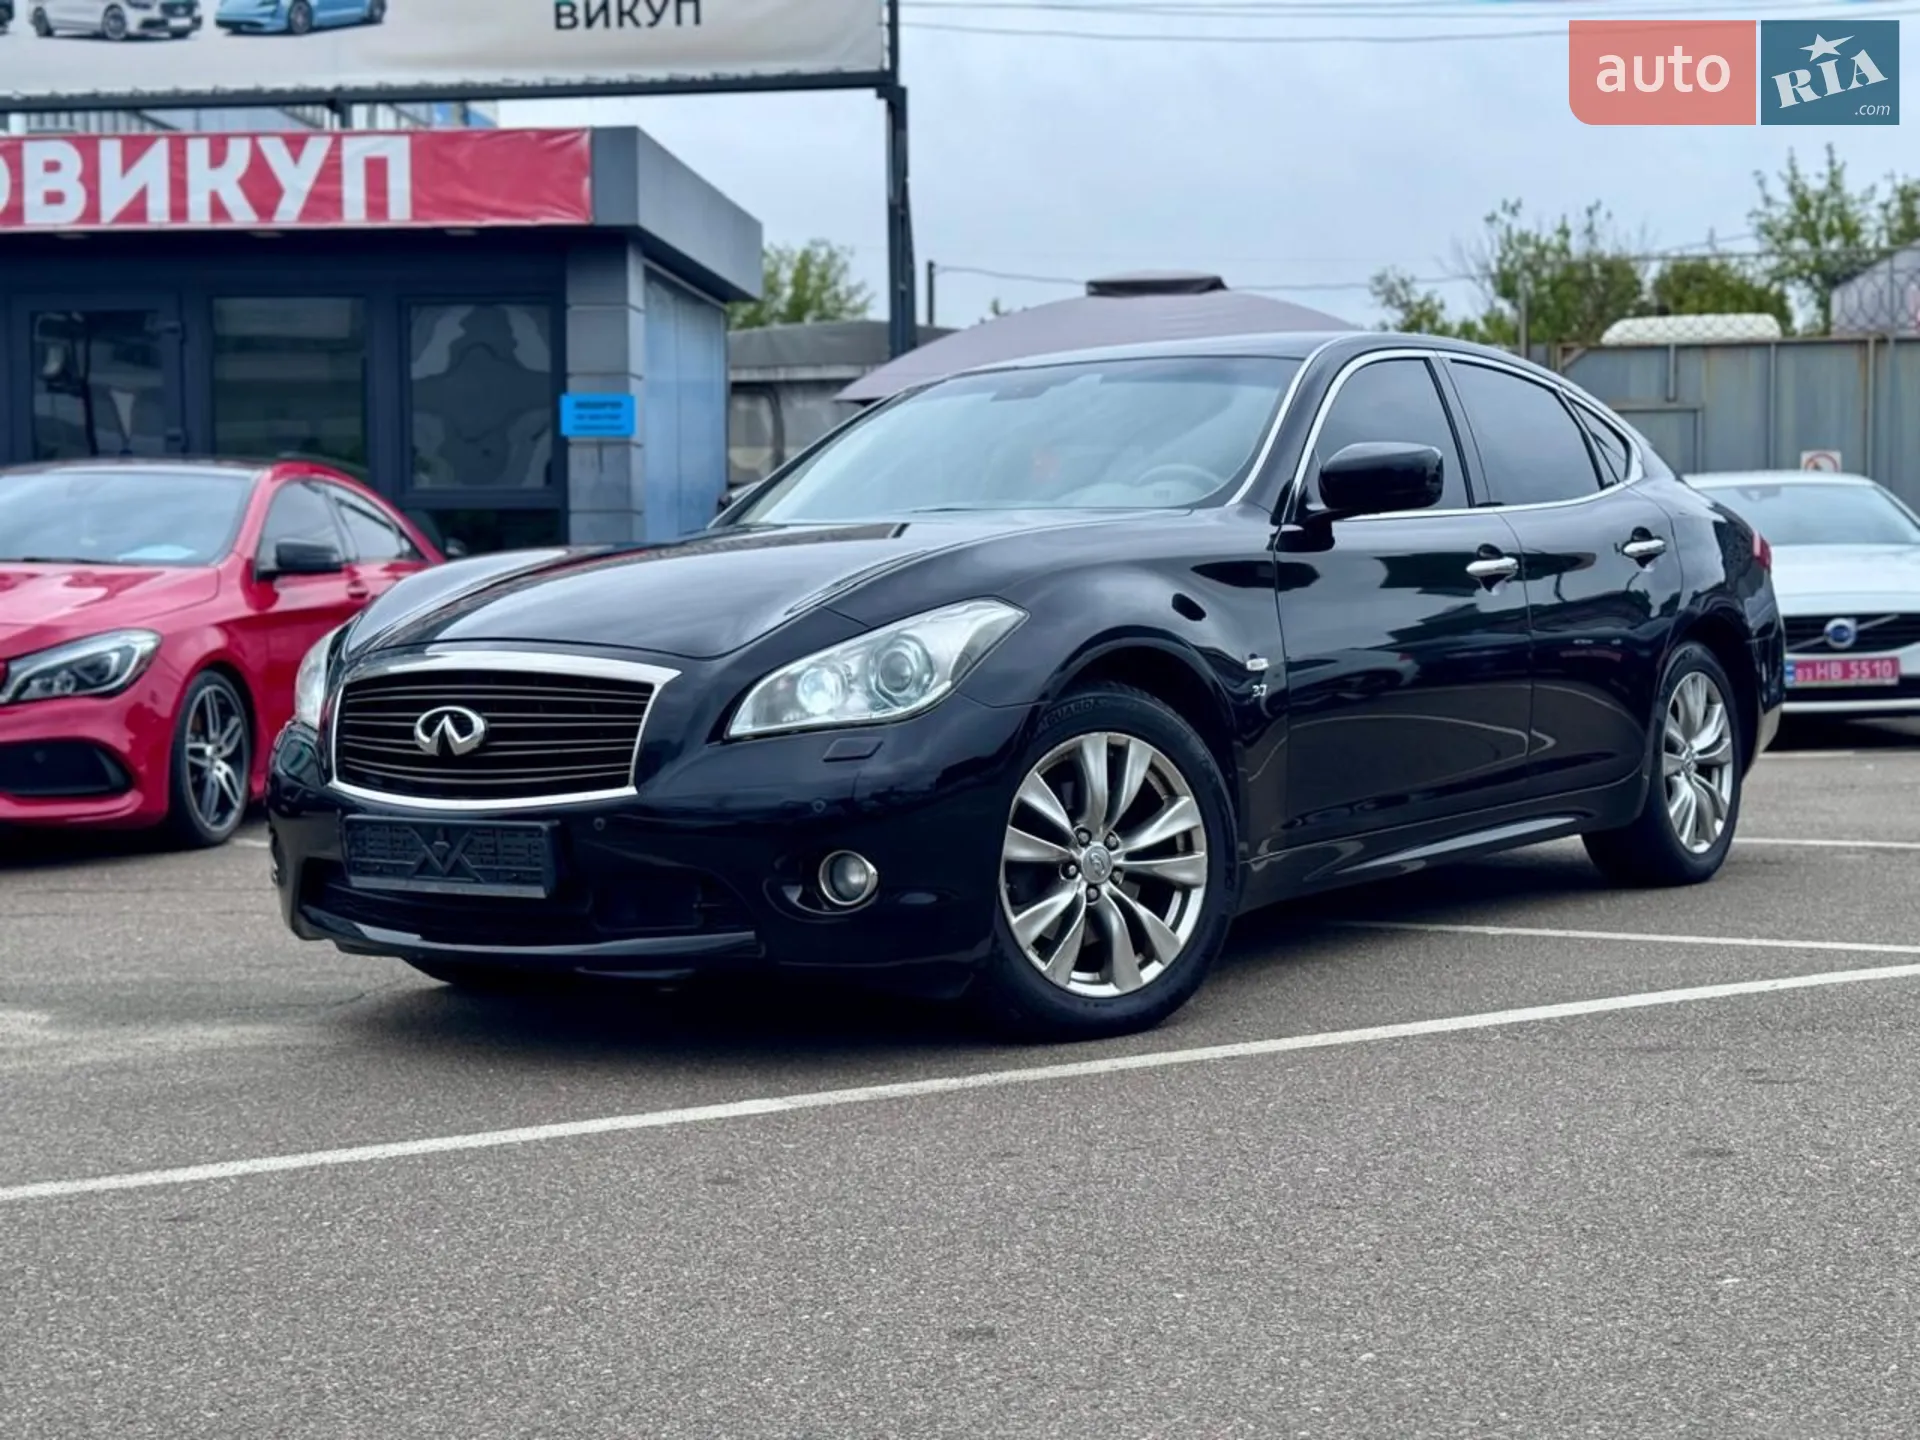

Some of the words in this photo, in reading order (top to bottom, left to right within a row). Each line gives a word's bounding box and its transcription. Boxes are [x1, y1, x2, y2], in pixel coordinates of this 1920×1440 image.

[554, 0, 701, 30] ВИКУП
[0, 135, 412, 224] ВИКУП
[1849, 660, 1892, 679] 5510
